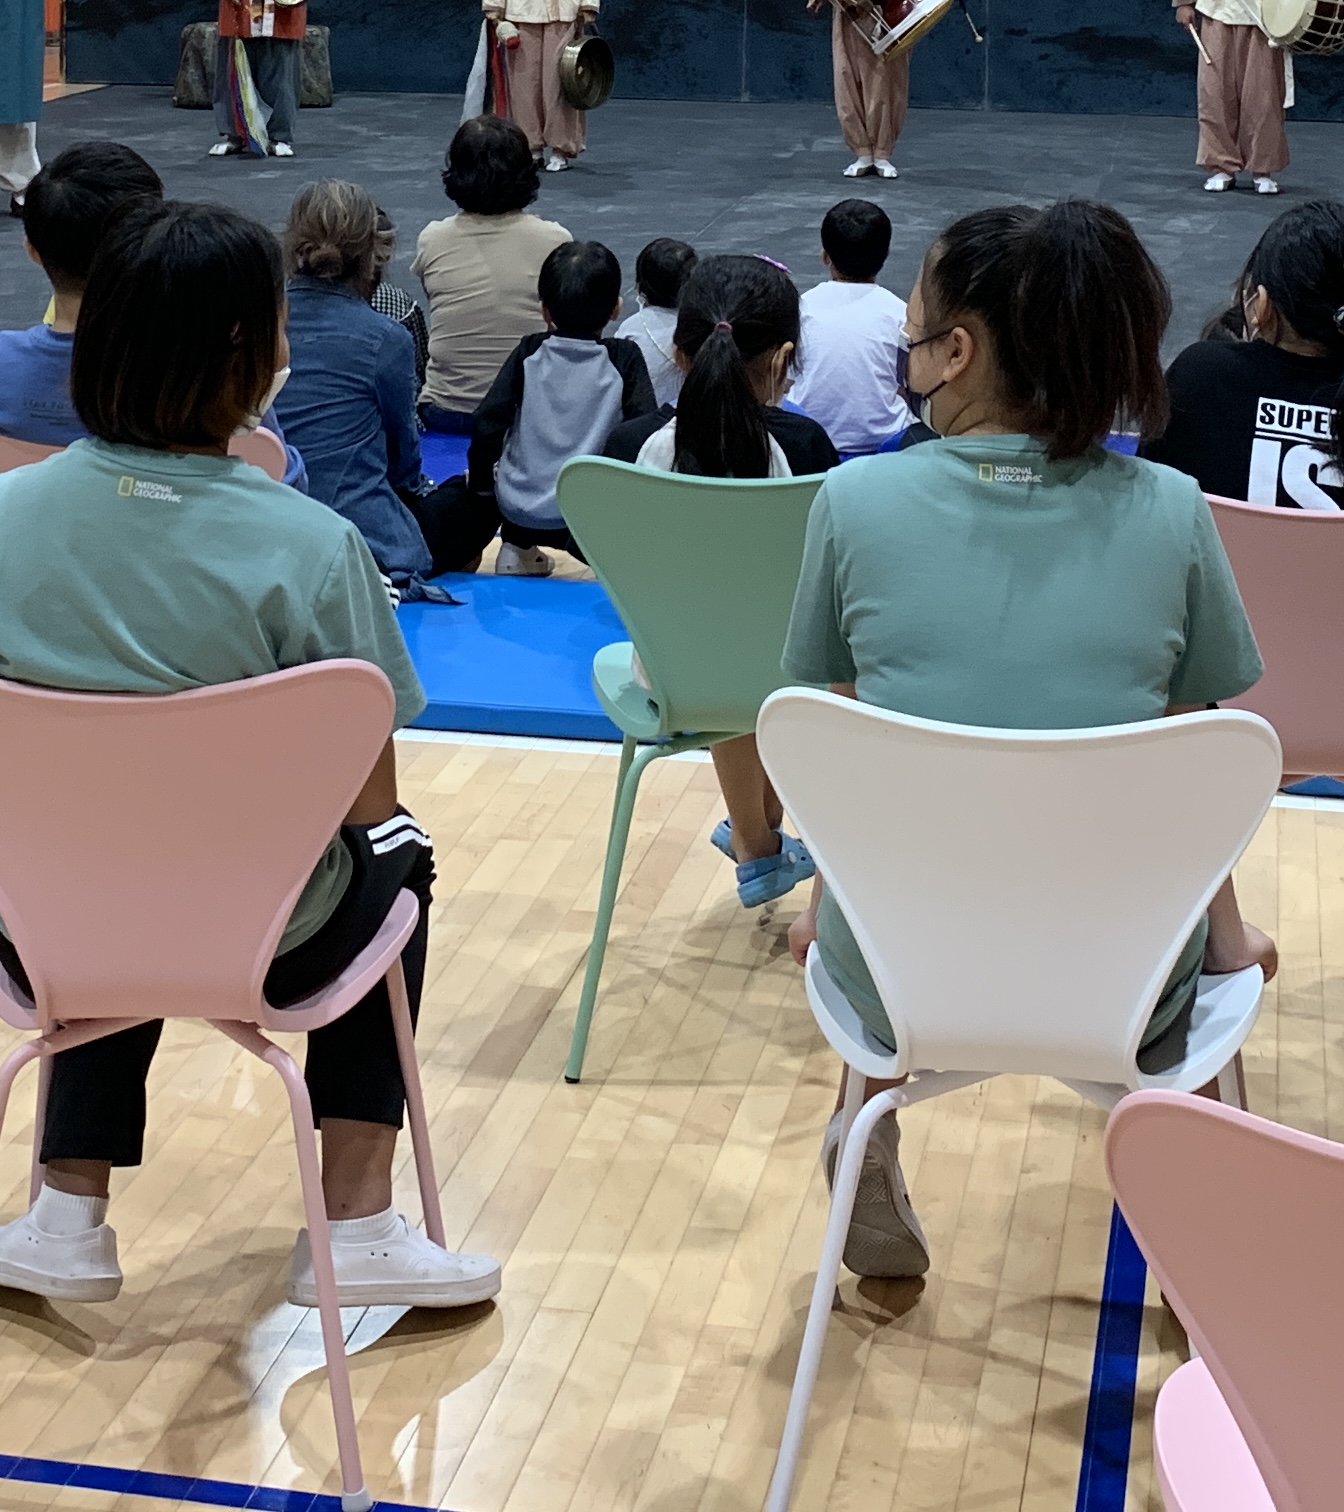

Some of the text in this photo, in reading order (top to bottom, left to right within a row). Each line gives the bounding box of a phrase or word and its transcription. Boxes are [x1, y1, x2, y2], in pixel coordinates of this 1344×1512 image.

[1259, 402, 1338, 436] SUPE
[995, 465, 1033, 475] NATIONAL
[136, 480, 173, 493] NATIONAL
